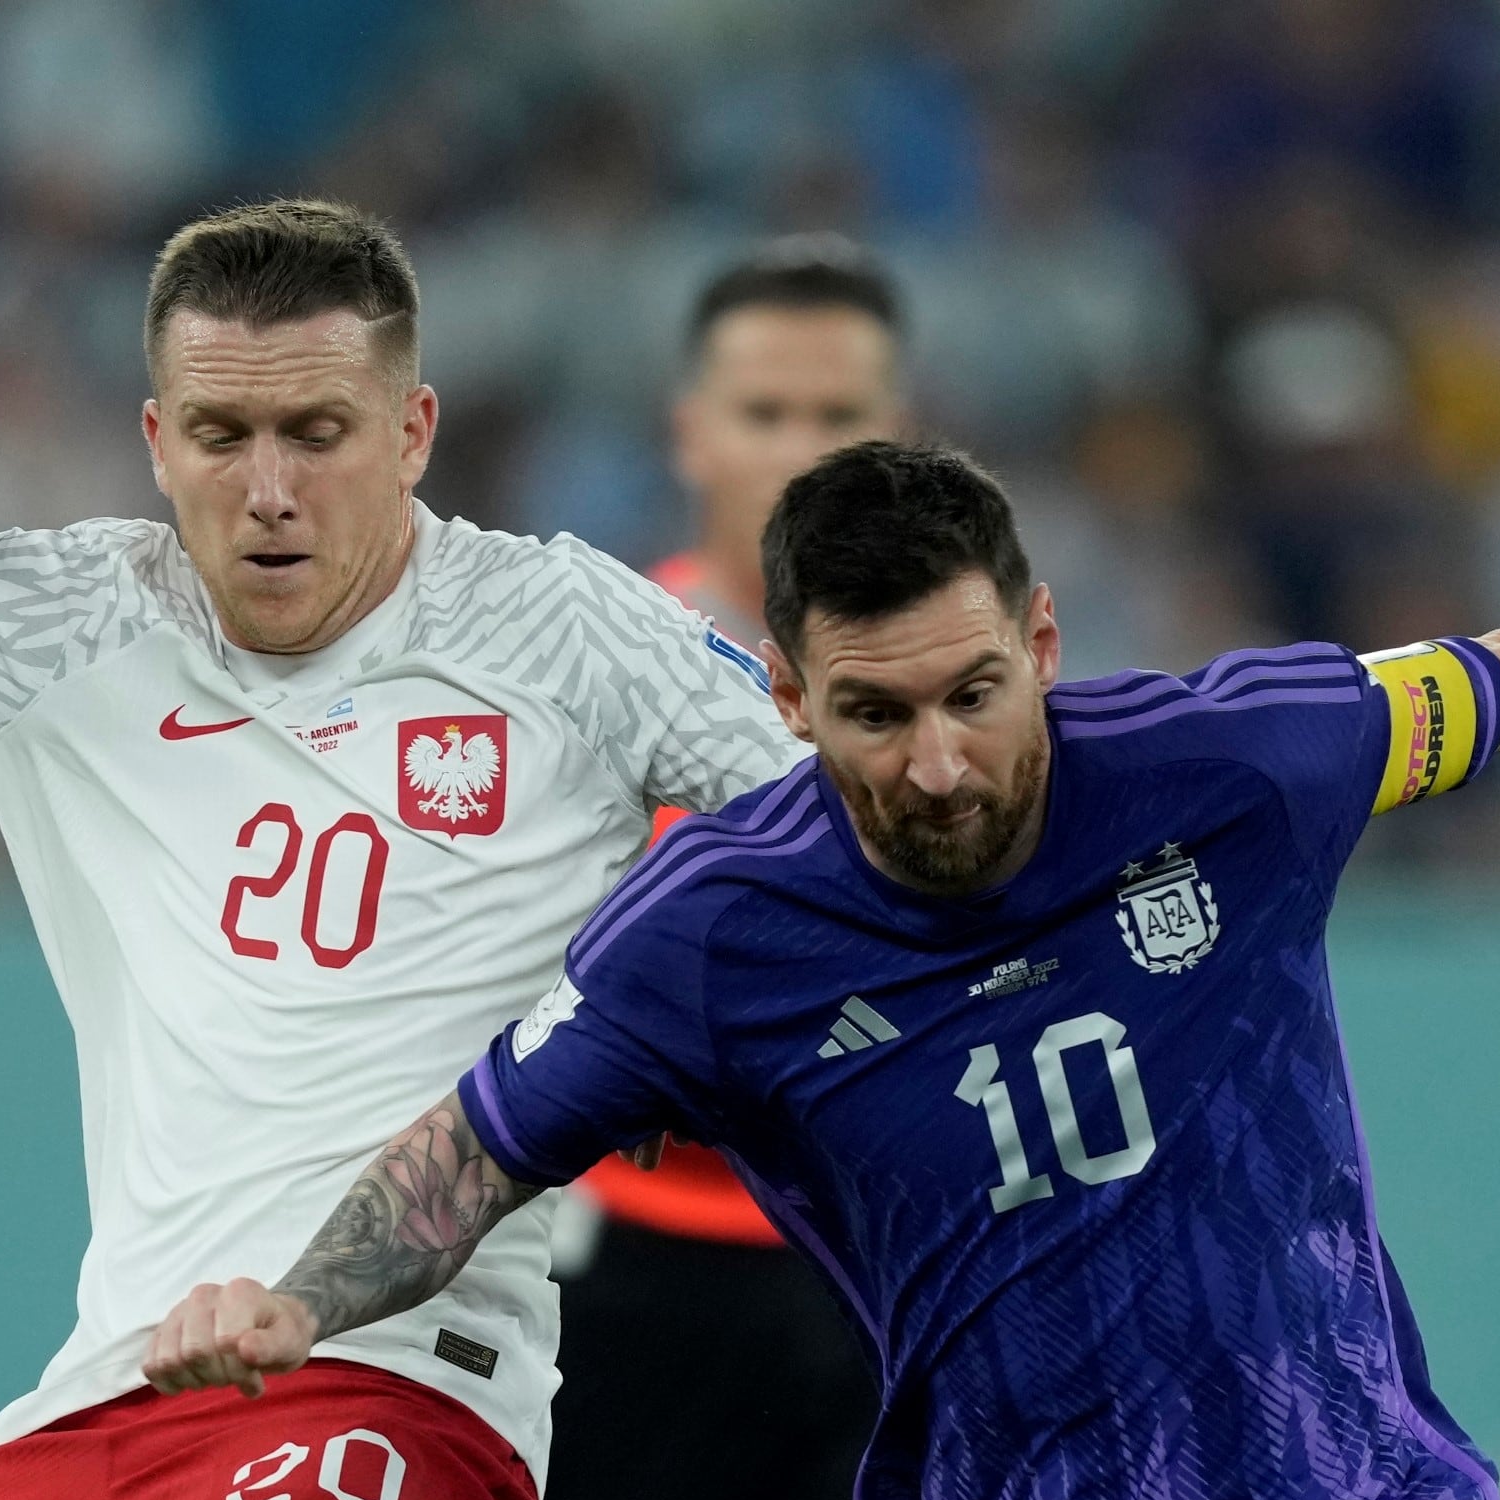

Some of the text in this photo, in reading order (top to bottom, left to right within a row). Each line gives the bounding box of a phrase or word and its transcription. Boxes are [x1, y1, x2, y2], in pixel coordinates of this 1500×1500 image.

[310, 720, 358, 740] ARGENTINA
[220, 802, 390, 969] 20
[1143, 889, 1197, 939] AFA
[967, 958, 1060, 997] 30 NOVEMBER 2022
[992, 958, 1028, 977] POLAND
[1026, 973, 1048, 987] 974
[953, 1011, 1156, 1214] 10
